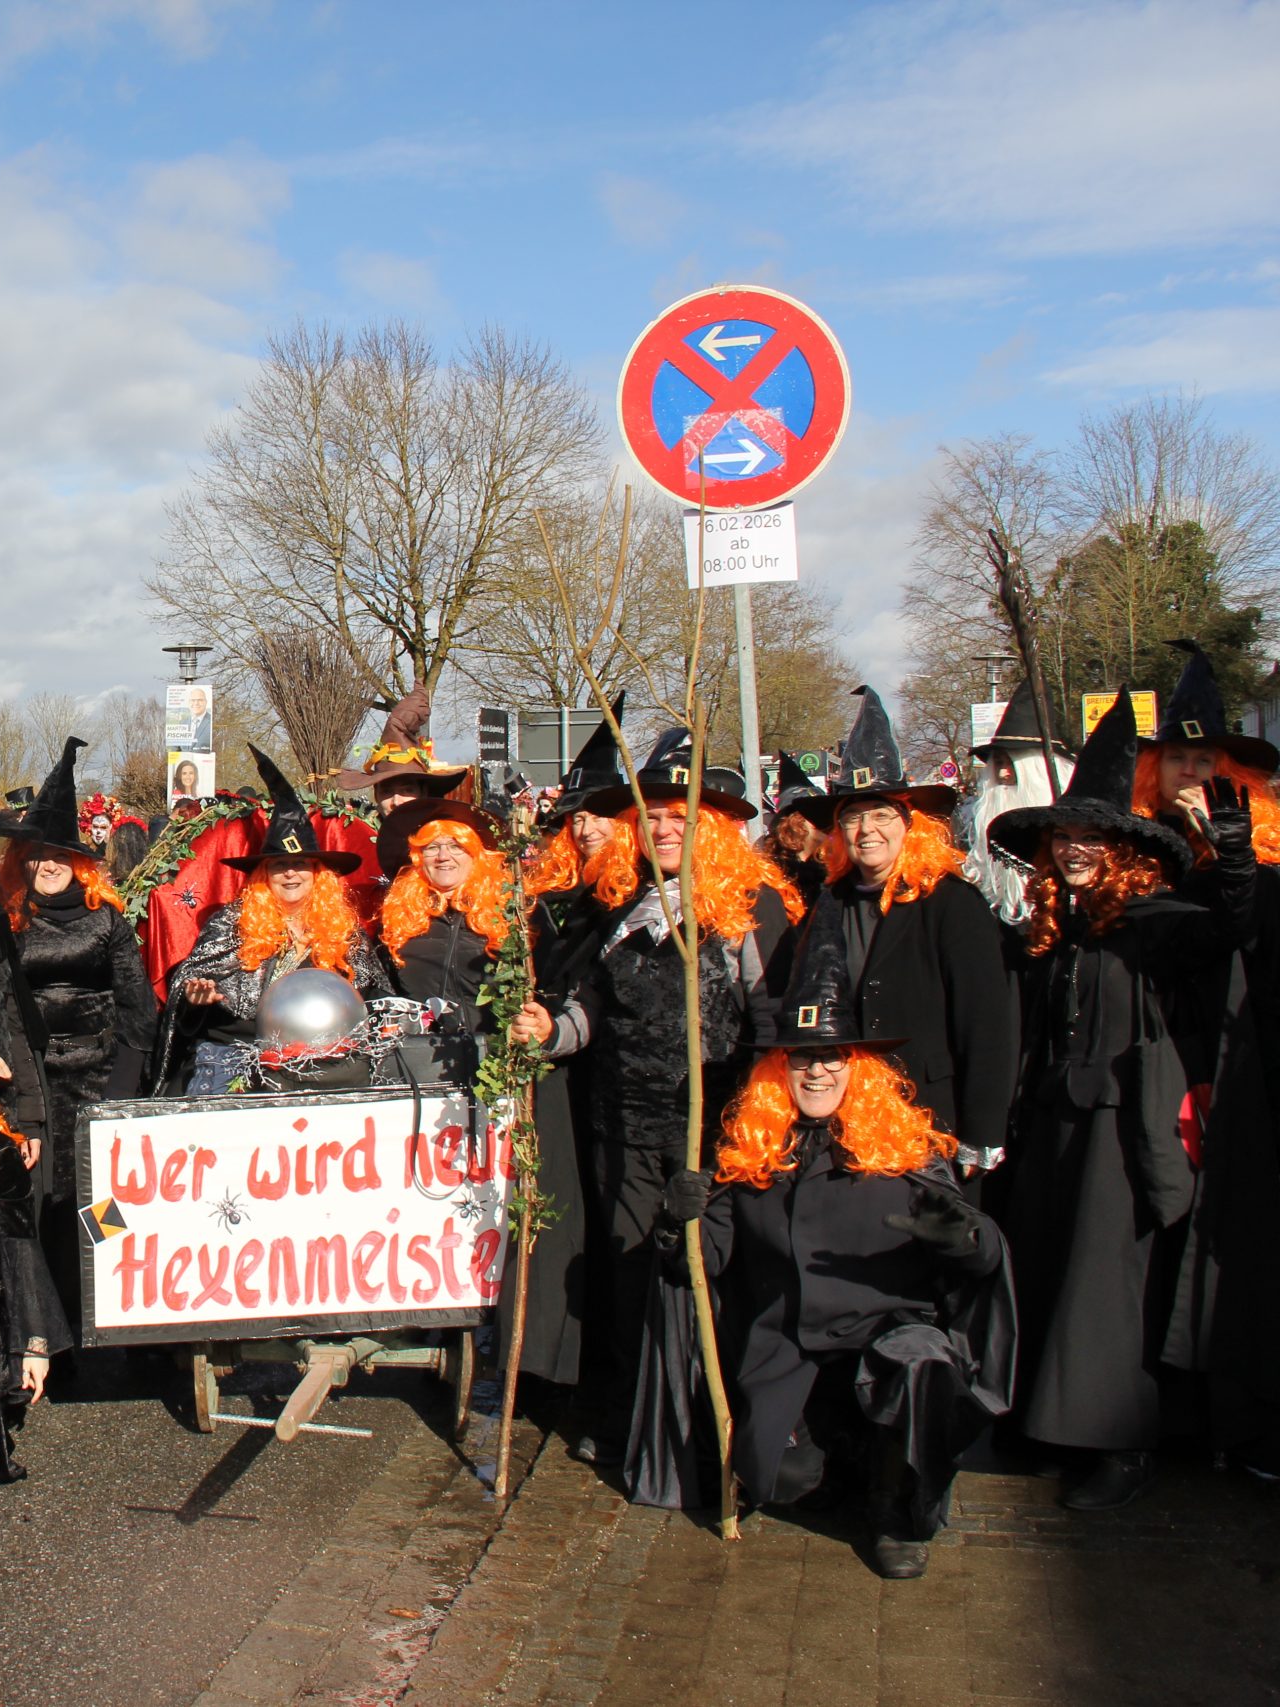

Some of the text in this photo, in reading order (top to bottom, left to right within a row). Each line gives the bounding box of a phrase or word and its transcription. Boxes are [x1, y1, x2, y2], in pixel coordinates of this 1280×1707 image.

[697, 514, 782, 533] 6.02.2026
[730, 536, 750, 550] ab
[704, 555, 780, 573] 08:00 Uhr
[110, 1130, 217, 1205] Wer
[247, 1116, 382, 1201] wird
